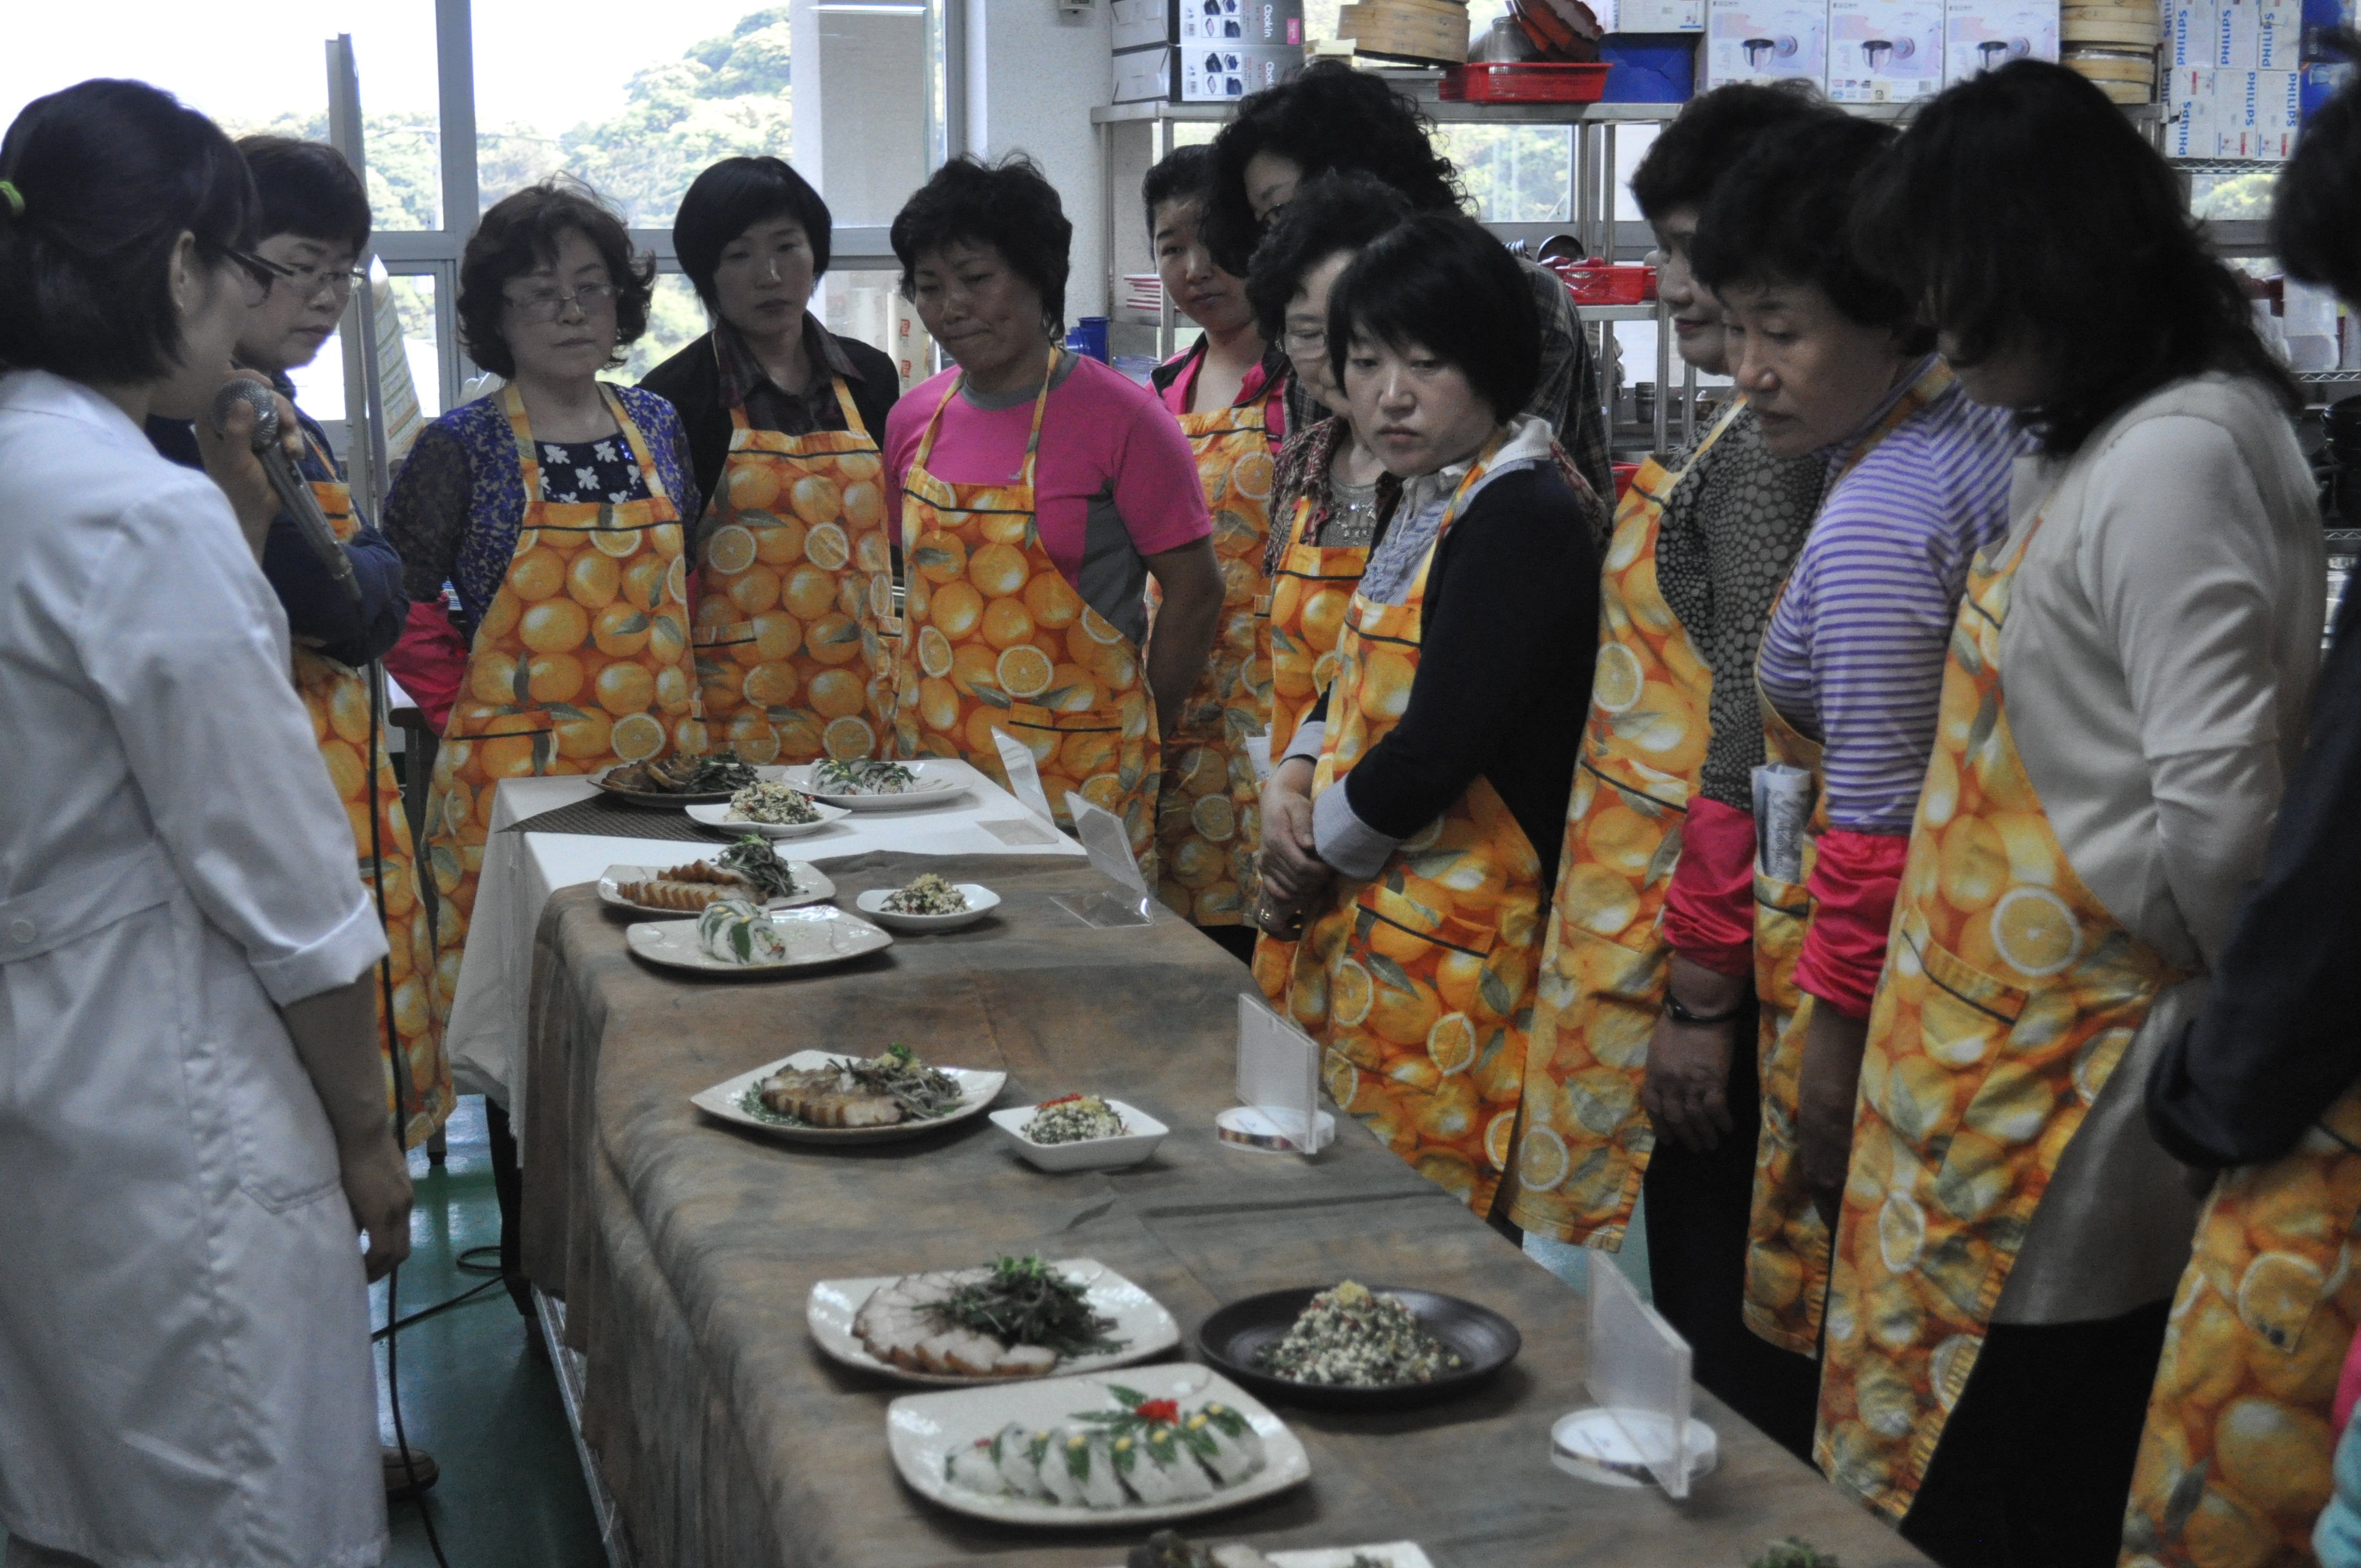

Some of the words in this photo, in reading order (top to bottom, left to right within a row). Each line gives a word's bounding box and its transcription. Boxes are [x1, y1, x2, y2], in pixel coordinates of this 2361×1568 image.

[2177, 10, 2188, 66] PHILIPS
[2221, 9, 2231, 65] PHILIPS
[2262, 13, 2275, 67] PHILIPS
[2245, 72, 2255, 126] PHILIPS
[2287, 73, 2297, 127] PHILIPS
[2178, 101, 2192, 155] PHILIPS
